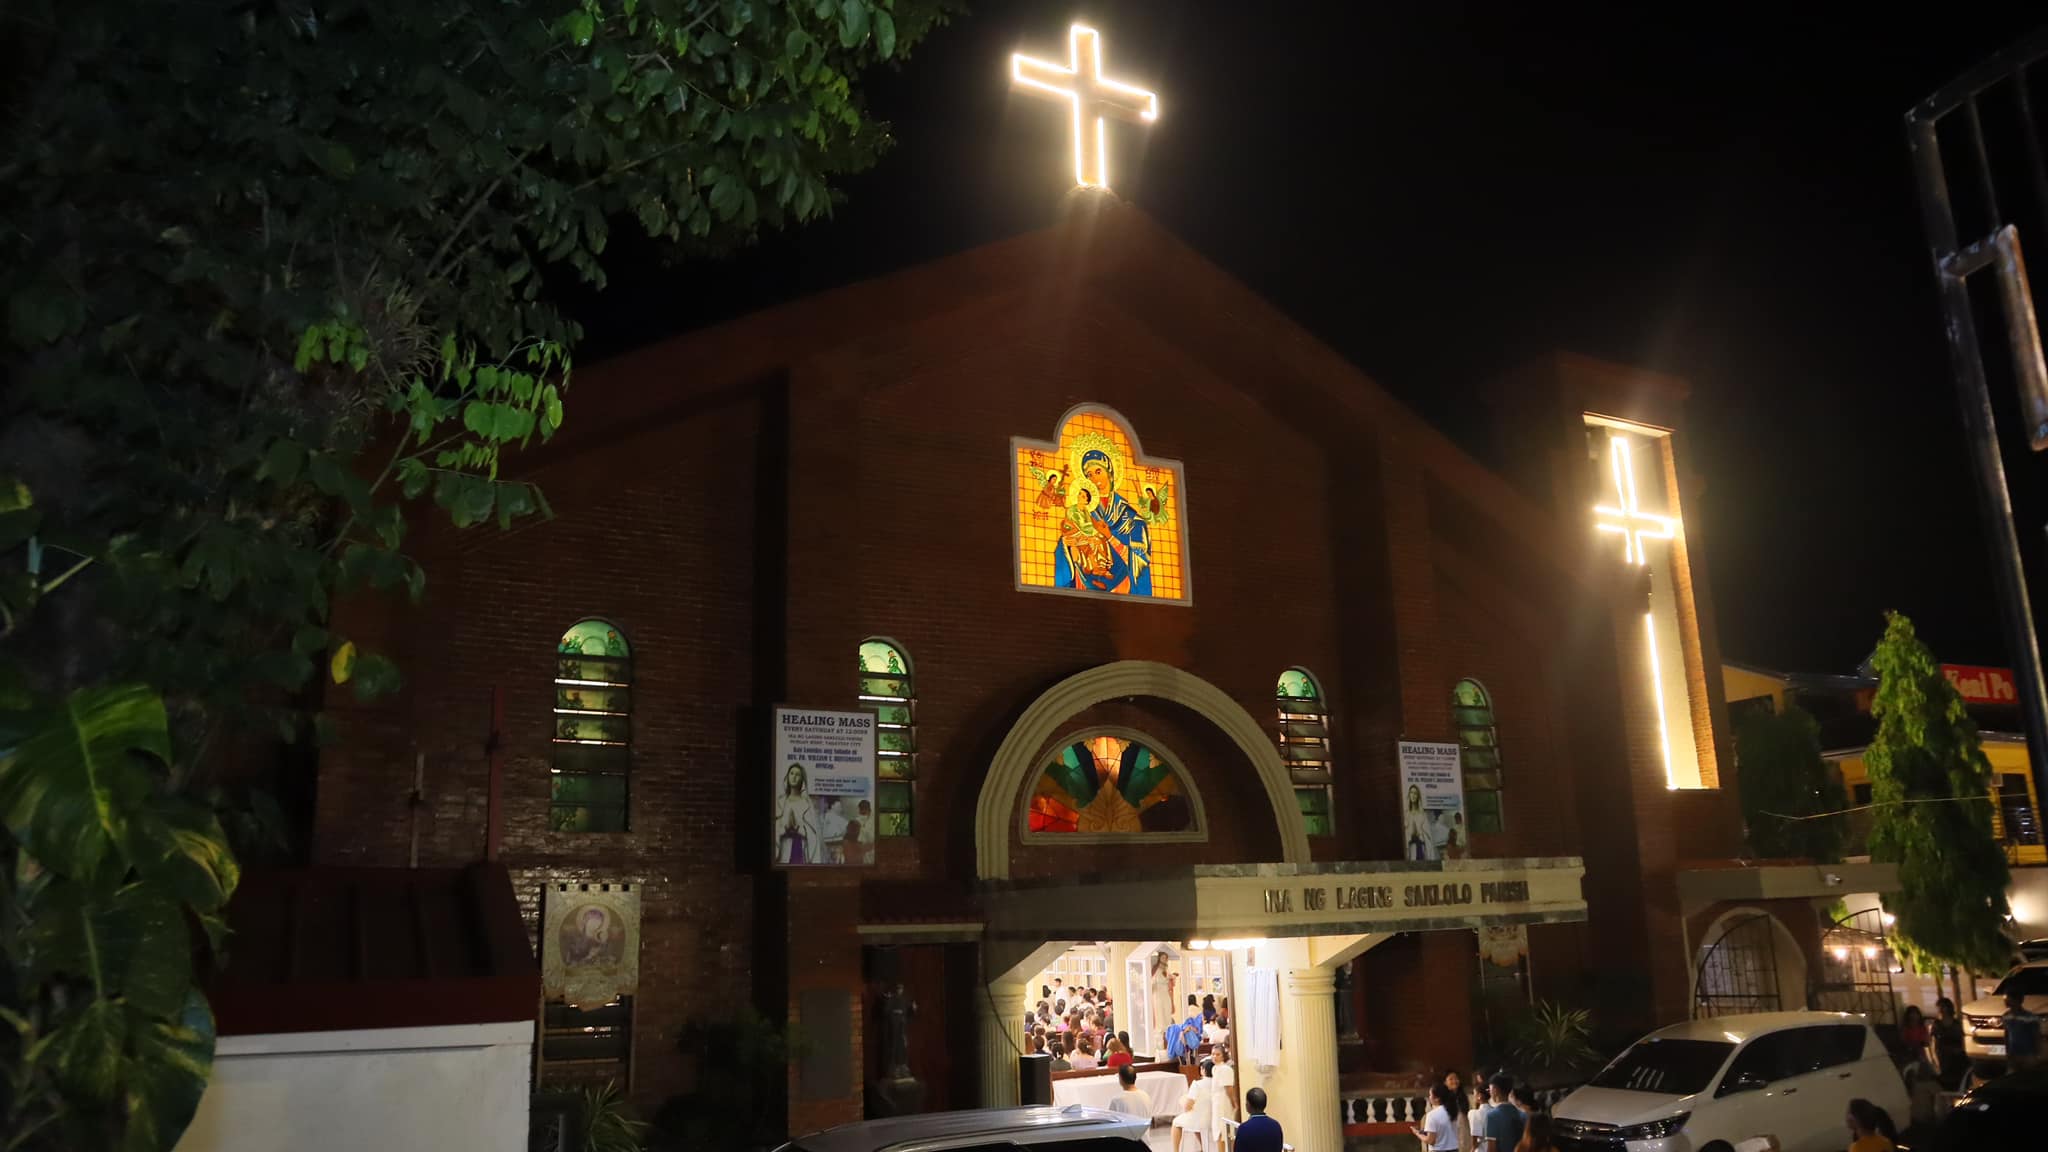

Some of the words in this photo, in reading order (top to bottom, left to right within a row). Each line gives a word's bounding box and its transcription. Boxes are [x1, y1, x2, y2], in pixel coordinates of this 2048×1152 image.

[782, 714, 835, 727] HEALING
[838, 717, 871, 728] MASS
[1401, 745, 1436, 755] HEALING
[1436, 747, 1457, 756] MASS
[1264, 888, 1293, 913] INA
[1303, 888, 1327, 911] NG
[1336, 886, 1392, 911] LAGING
[1404, 883, 1472, 908] SAKLOLO
[1480, 880, 1530, 904] PARISH
